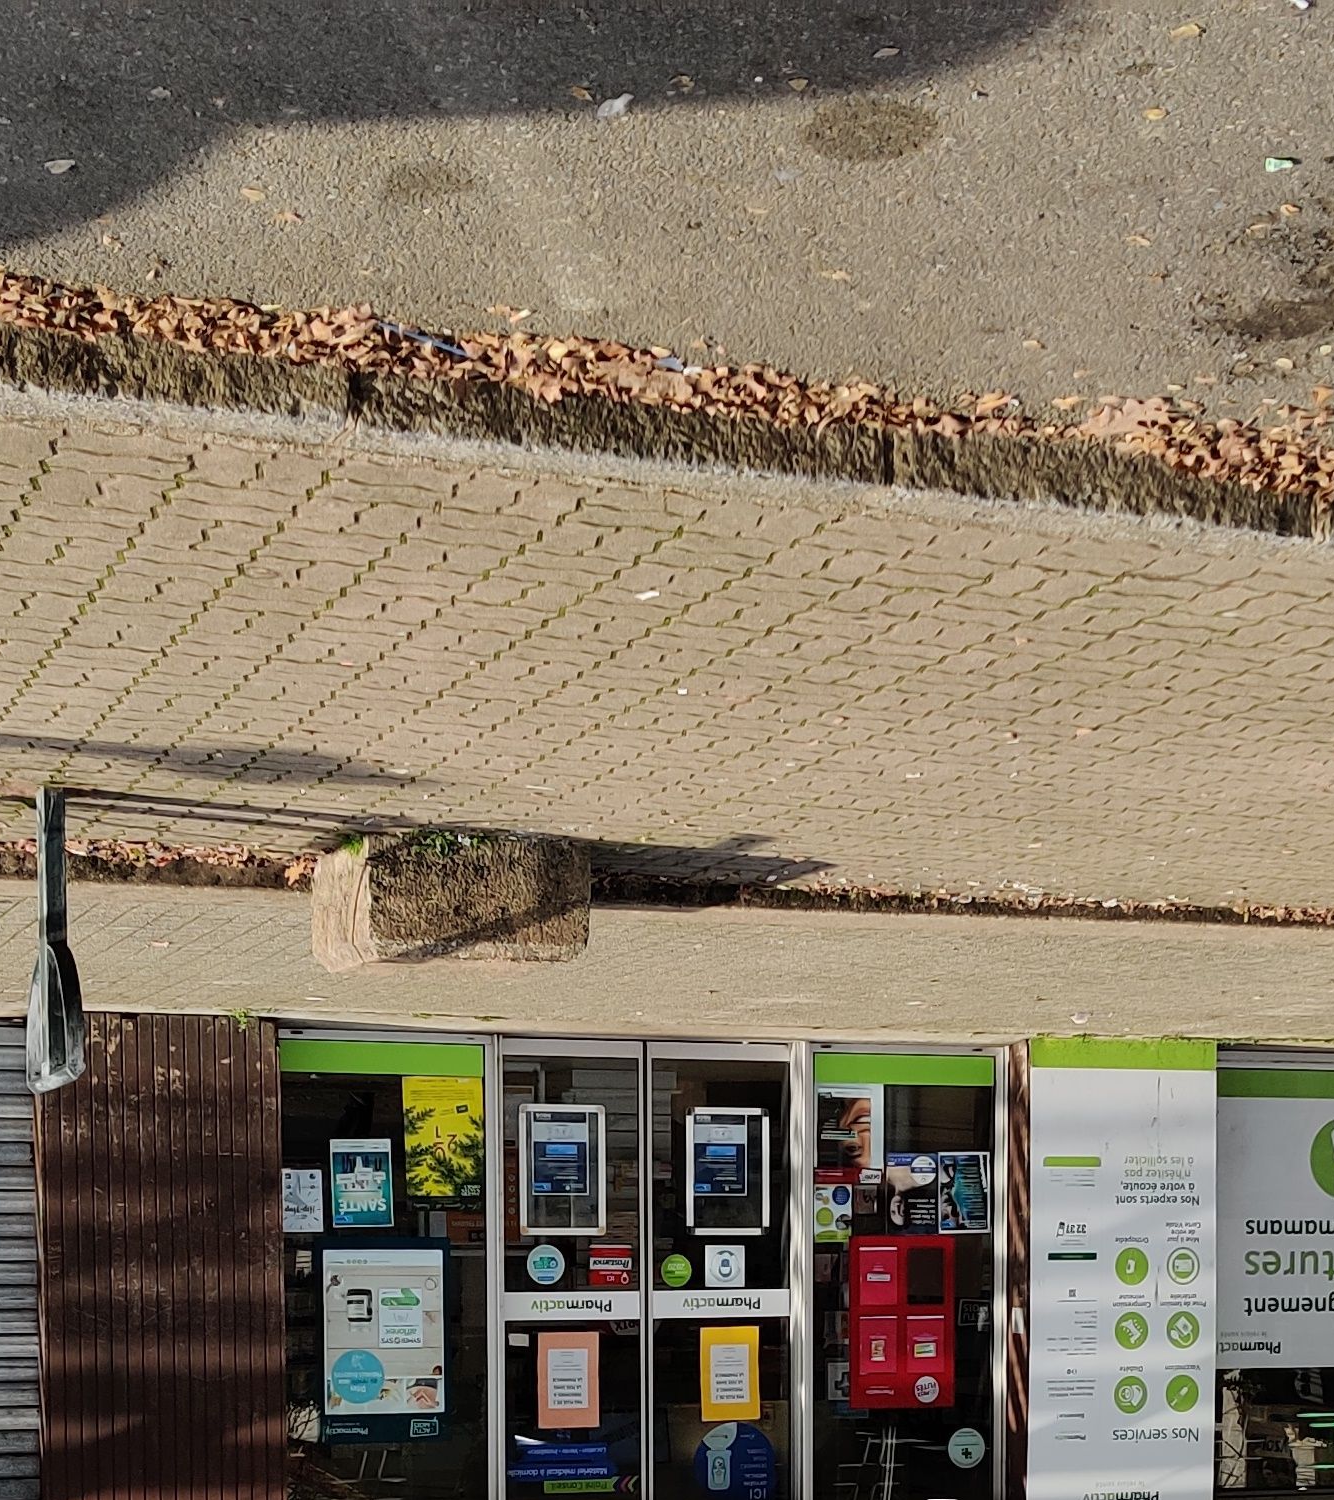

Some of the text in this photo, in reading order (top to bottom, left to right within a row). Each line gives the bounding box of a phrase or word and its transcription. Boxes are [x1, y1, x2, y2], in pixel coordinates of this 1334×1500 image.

[1124, 1155, 1194, 1166] à les solliciter
[1124, 1167, 1191, 1179] n'hésitez pas
[1120, 1181, 1195, 1193] à votre écoute,
[338, 1197, 387, 1215] SANTÉ
[1115, 1193, 1200, 1206] Nos experts sont
[531, 1299, 612, 1314] Pharmactiv
[682, 1296, 761, 1310] Pharmactiv
[1112, 1428, 1199, 1444] Nos services
[749, 1488, 766, 1499] ICI
